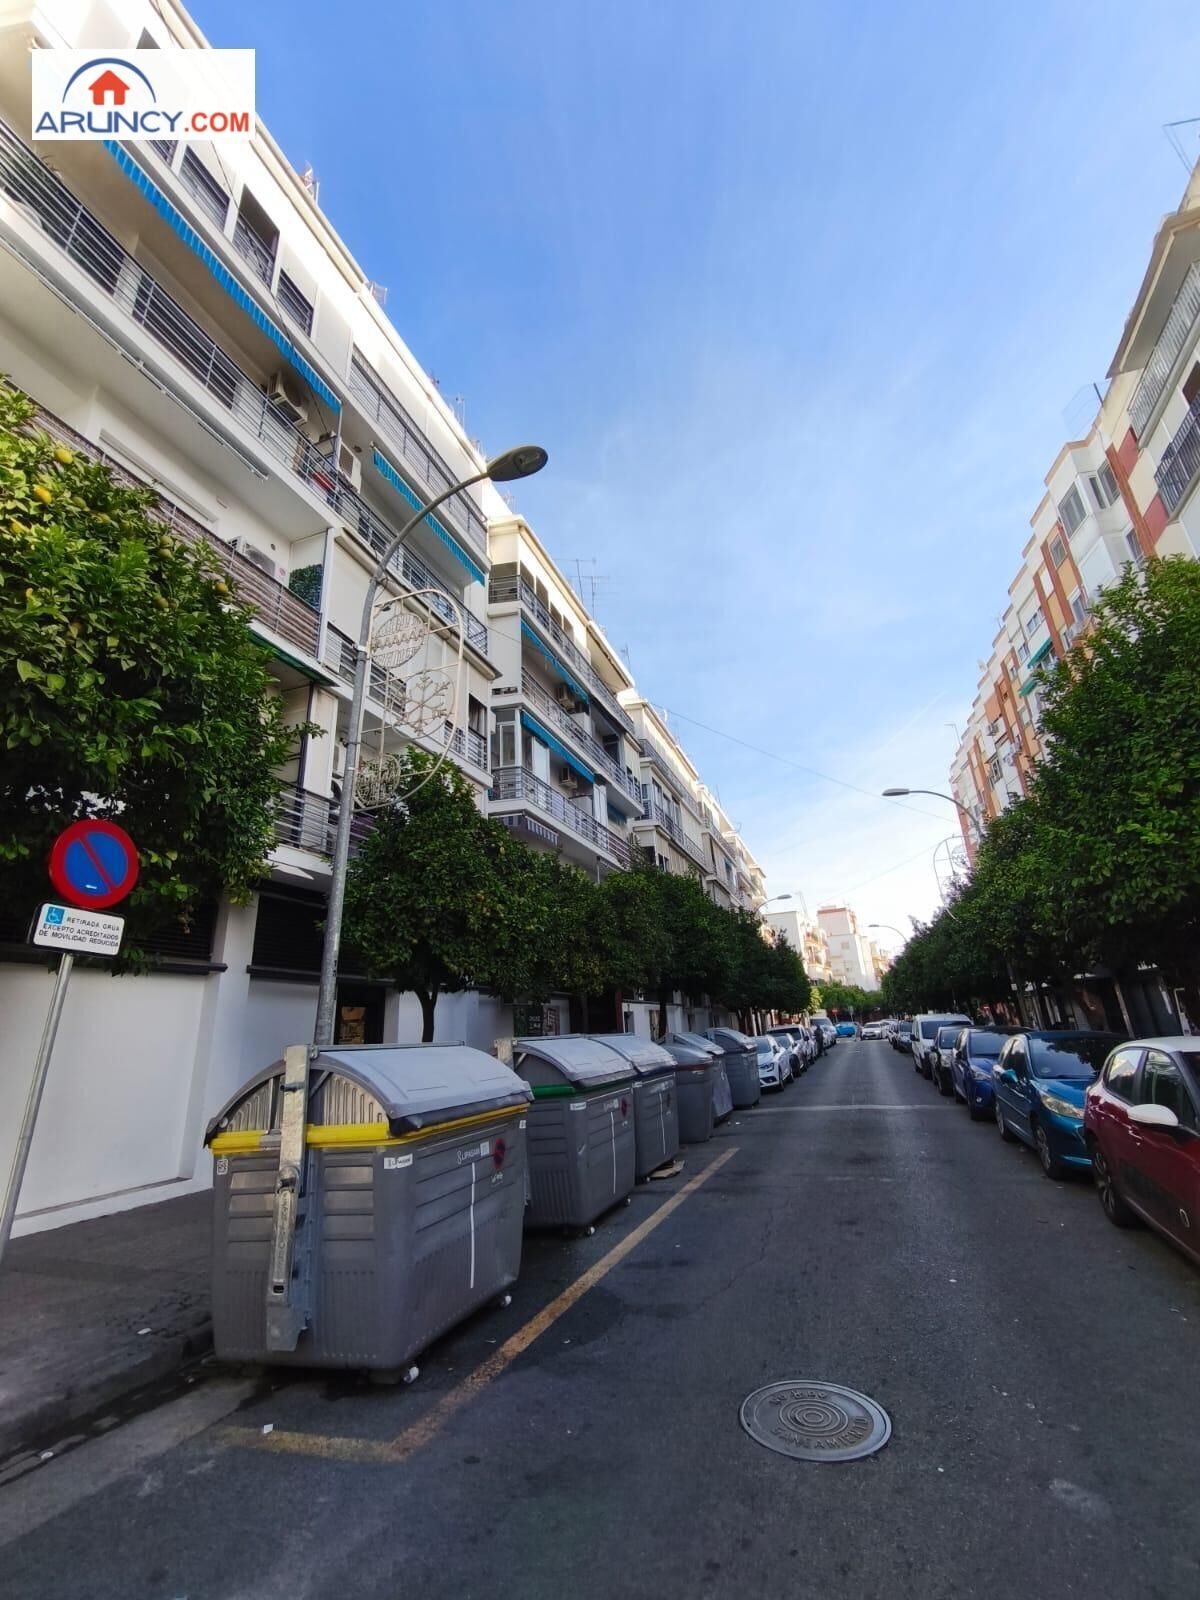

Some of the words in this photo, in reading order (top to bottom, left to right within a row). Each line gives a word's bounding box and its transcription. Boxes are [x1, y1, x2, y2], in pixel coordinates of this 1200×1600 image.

[67, 917, 99, 928] RETIRADA
[43, 923, 74, 934] EXCEPTO
[77, 930, 118, 941] ACREDITADOS
[52, 930, 87, 943] MOVILIDAD
[89, 938, 118, 947] REDUCIDA
